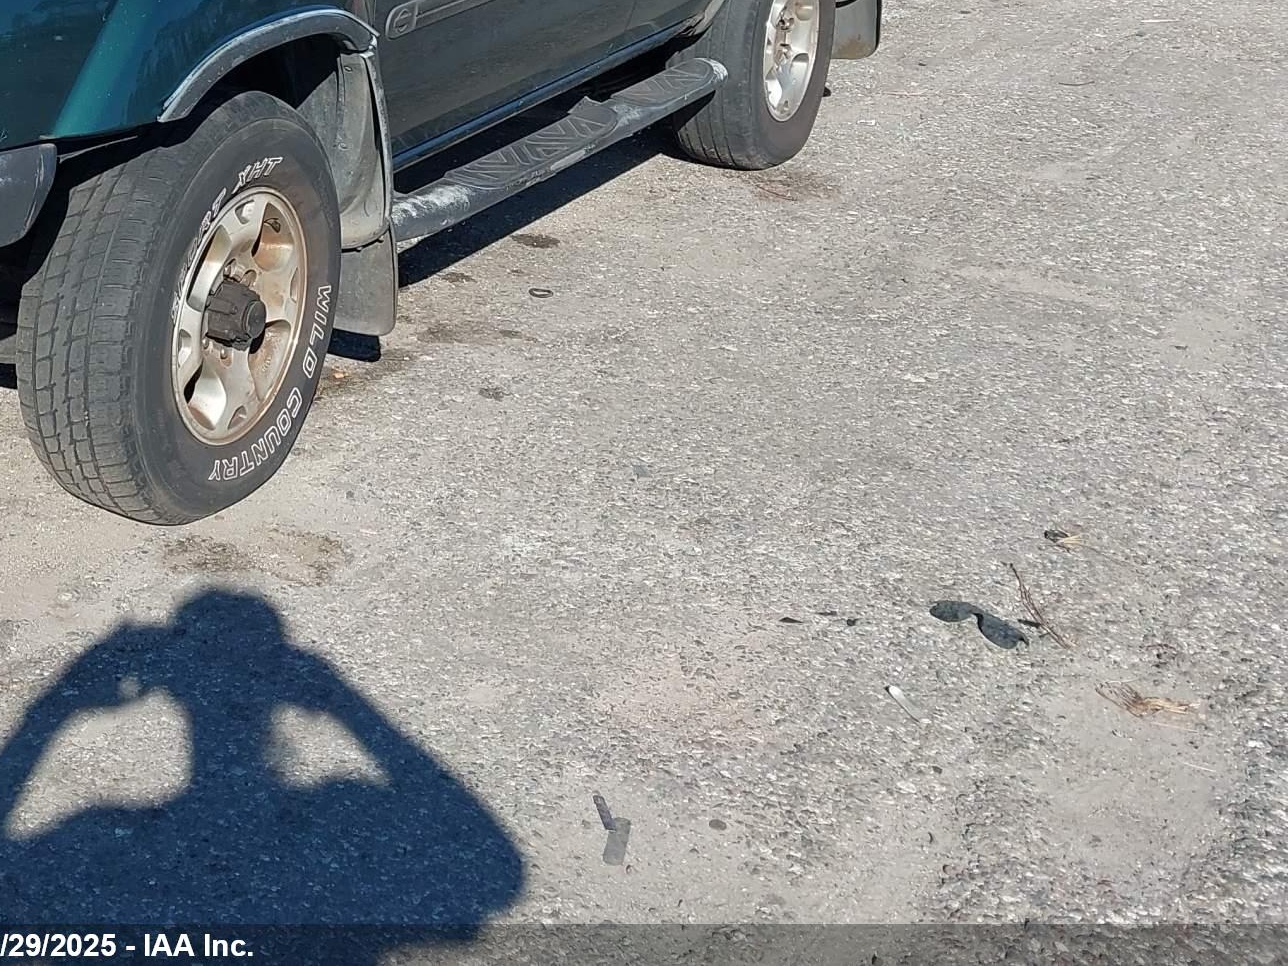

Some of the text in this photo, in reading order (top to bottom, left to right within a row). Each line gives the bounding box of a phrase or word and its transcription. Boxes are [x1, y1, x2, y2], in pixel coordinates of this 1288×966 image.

[231, 157, 283, 194] XHT
[208, 285, 332, 481] WILD COUNTRY
